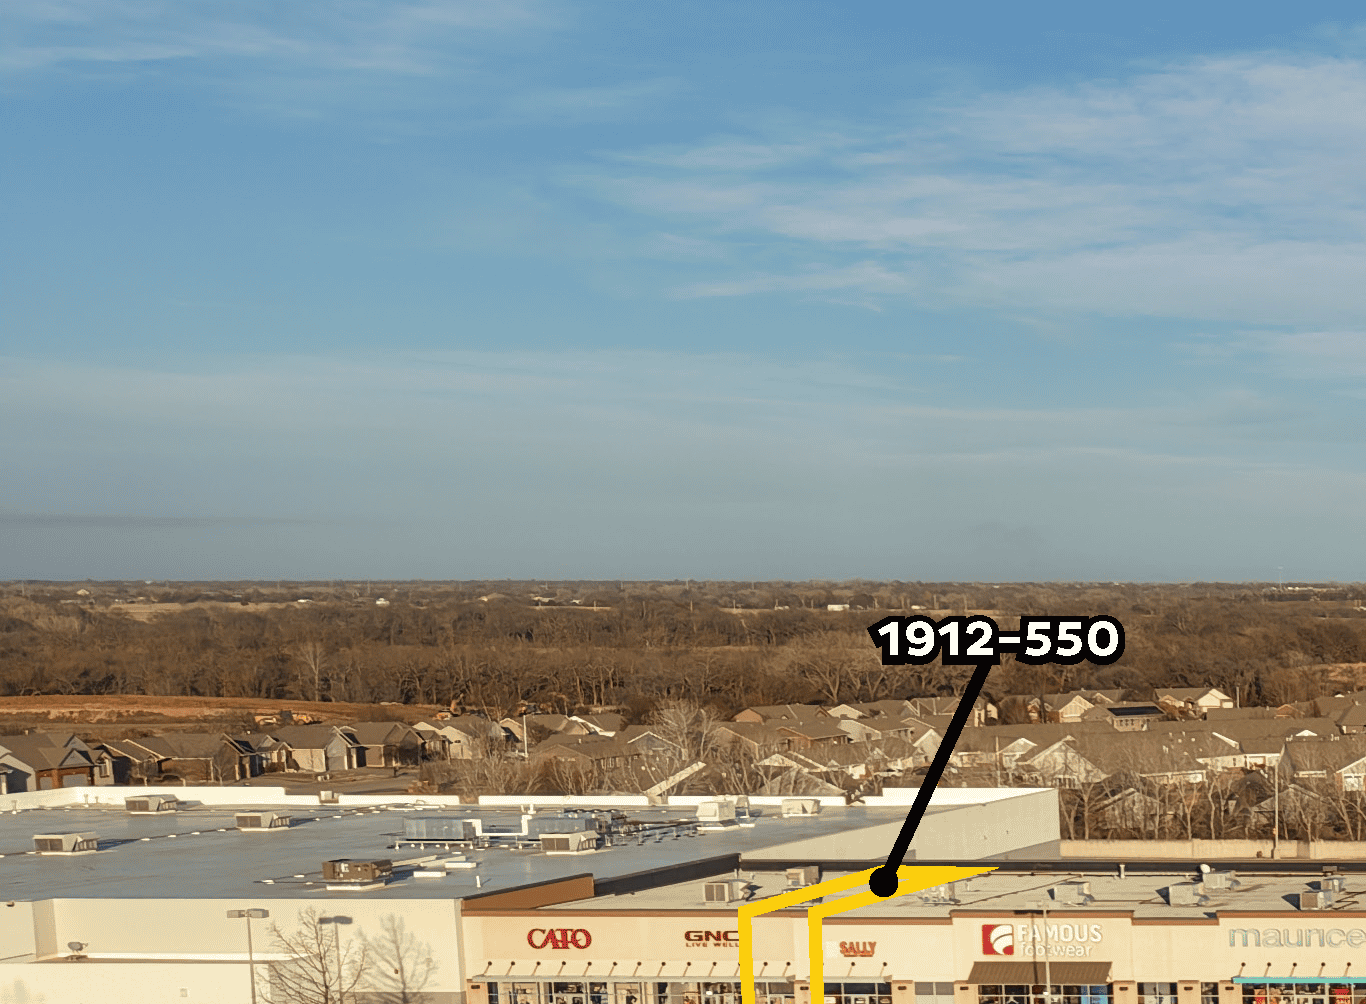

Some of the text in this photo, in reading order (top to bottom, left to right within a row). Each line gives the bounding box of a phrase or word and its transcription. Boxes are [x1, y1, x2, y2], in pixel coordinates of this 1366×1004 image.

[527, 928, 592, 949] CATO
[684, 930, 739, 942] GNC
[1017, 923, 1103, 943] FAMOUS
[839, 941, 877, 957] SALLY
[1021, 941, 1093, 957] footwear
